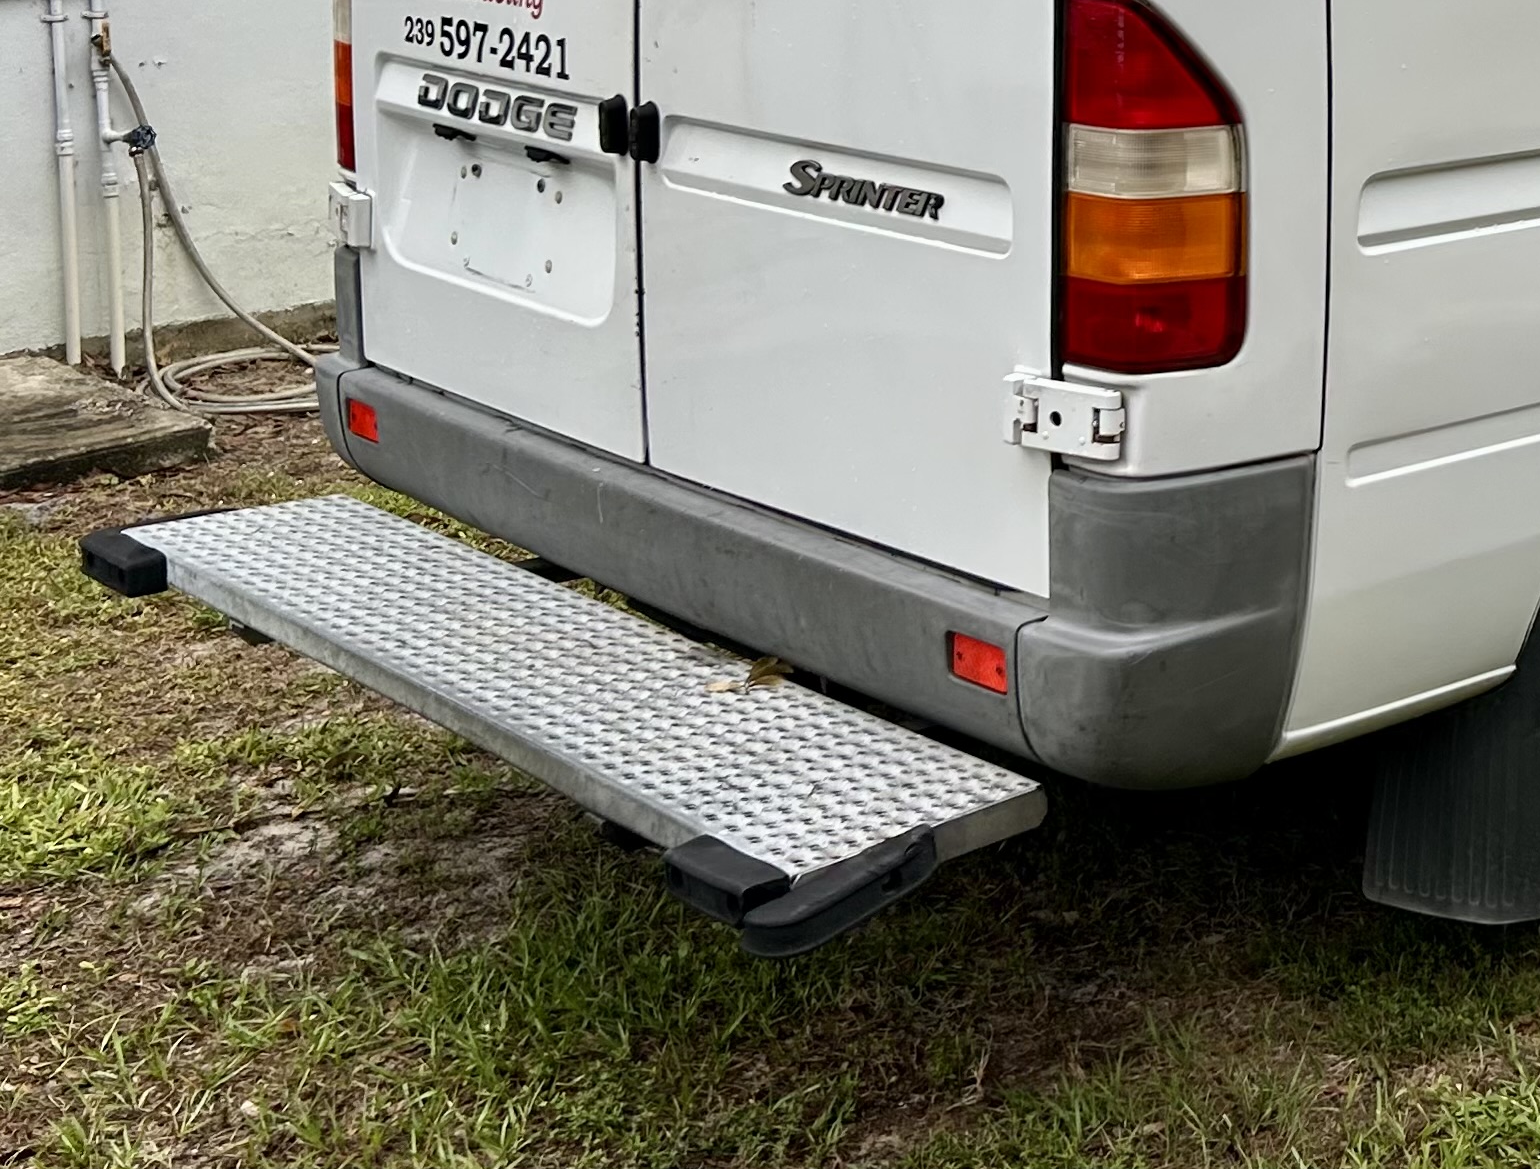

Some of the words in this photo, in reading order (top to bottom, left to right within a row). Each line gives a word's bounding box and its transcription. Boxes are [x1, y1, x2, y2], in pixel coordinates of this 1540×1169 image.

[404, 16, 435, 46] 239
[438, 16, 570, 80] 597-2421
[418, 73, 578, 142] DODGE
